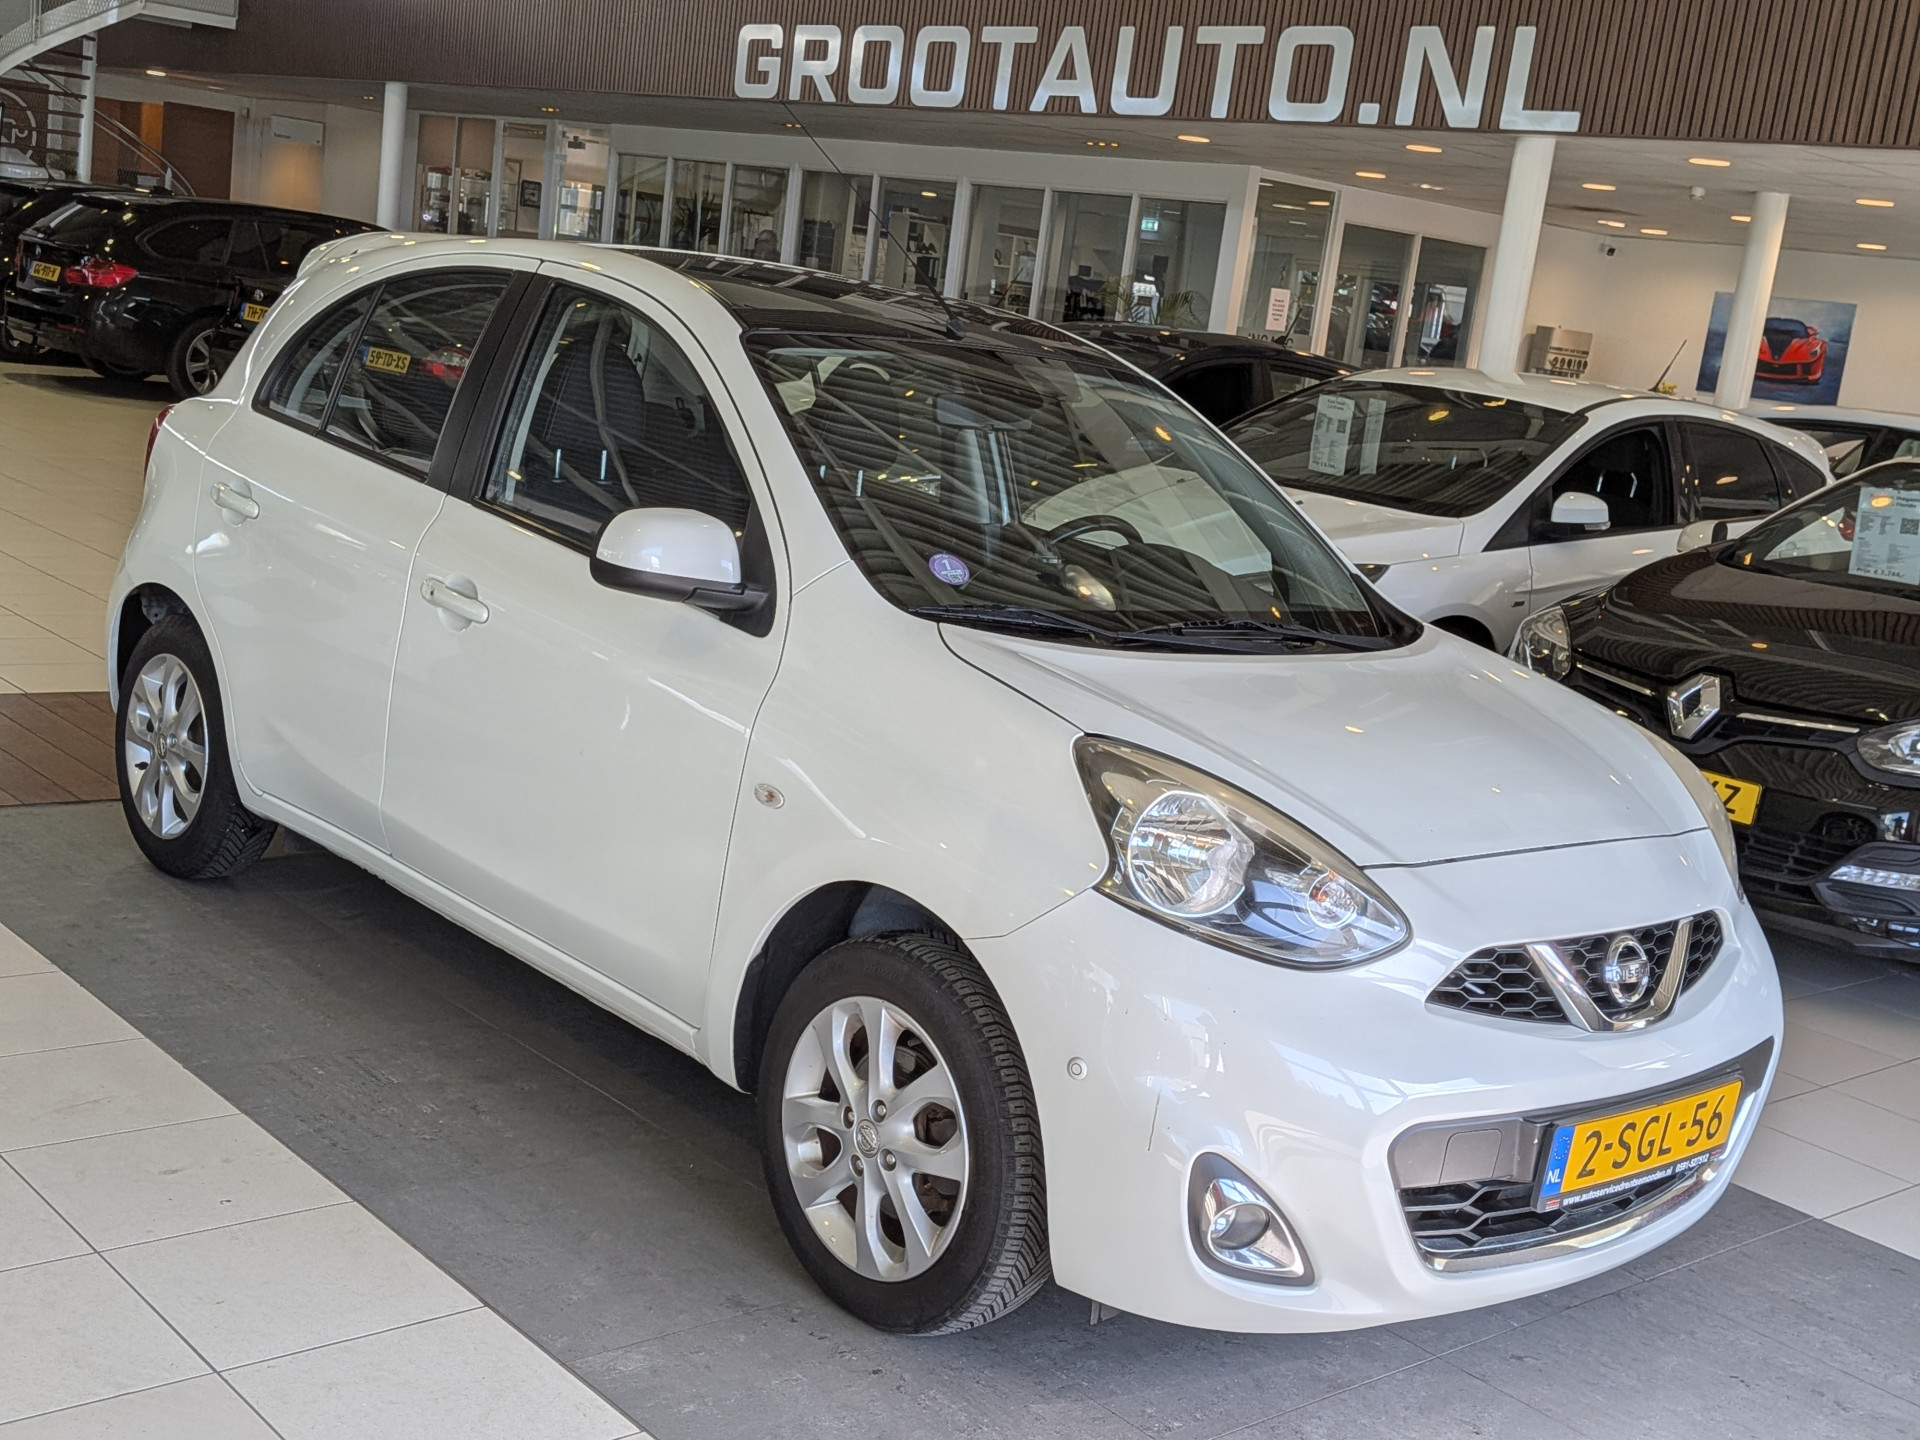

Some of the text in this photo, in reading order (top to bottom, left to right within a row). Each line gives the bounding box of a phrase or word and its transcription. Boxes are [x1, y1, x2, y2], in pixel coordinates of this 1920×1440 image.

[733, 23, 1581, 132] GROOTAUTO.NL
[369, 350, 408, 370] 59-TD-XS
[1711, 780, 1741, 814] Z
[1575, 1094, 1726, 1179] 2-SGL-56
[1545, 1168, 1561, 1185] NL
